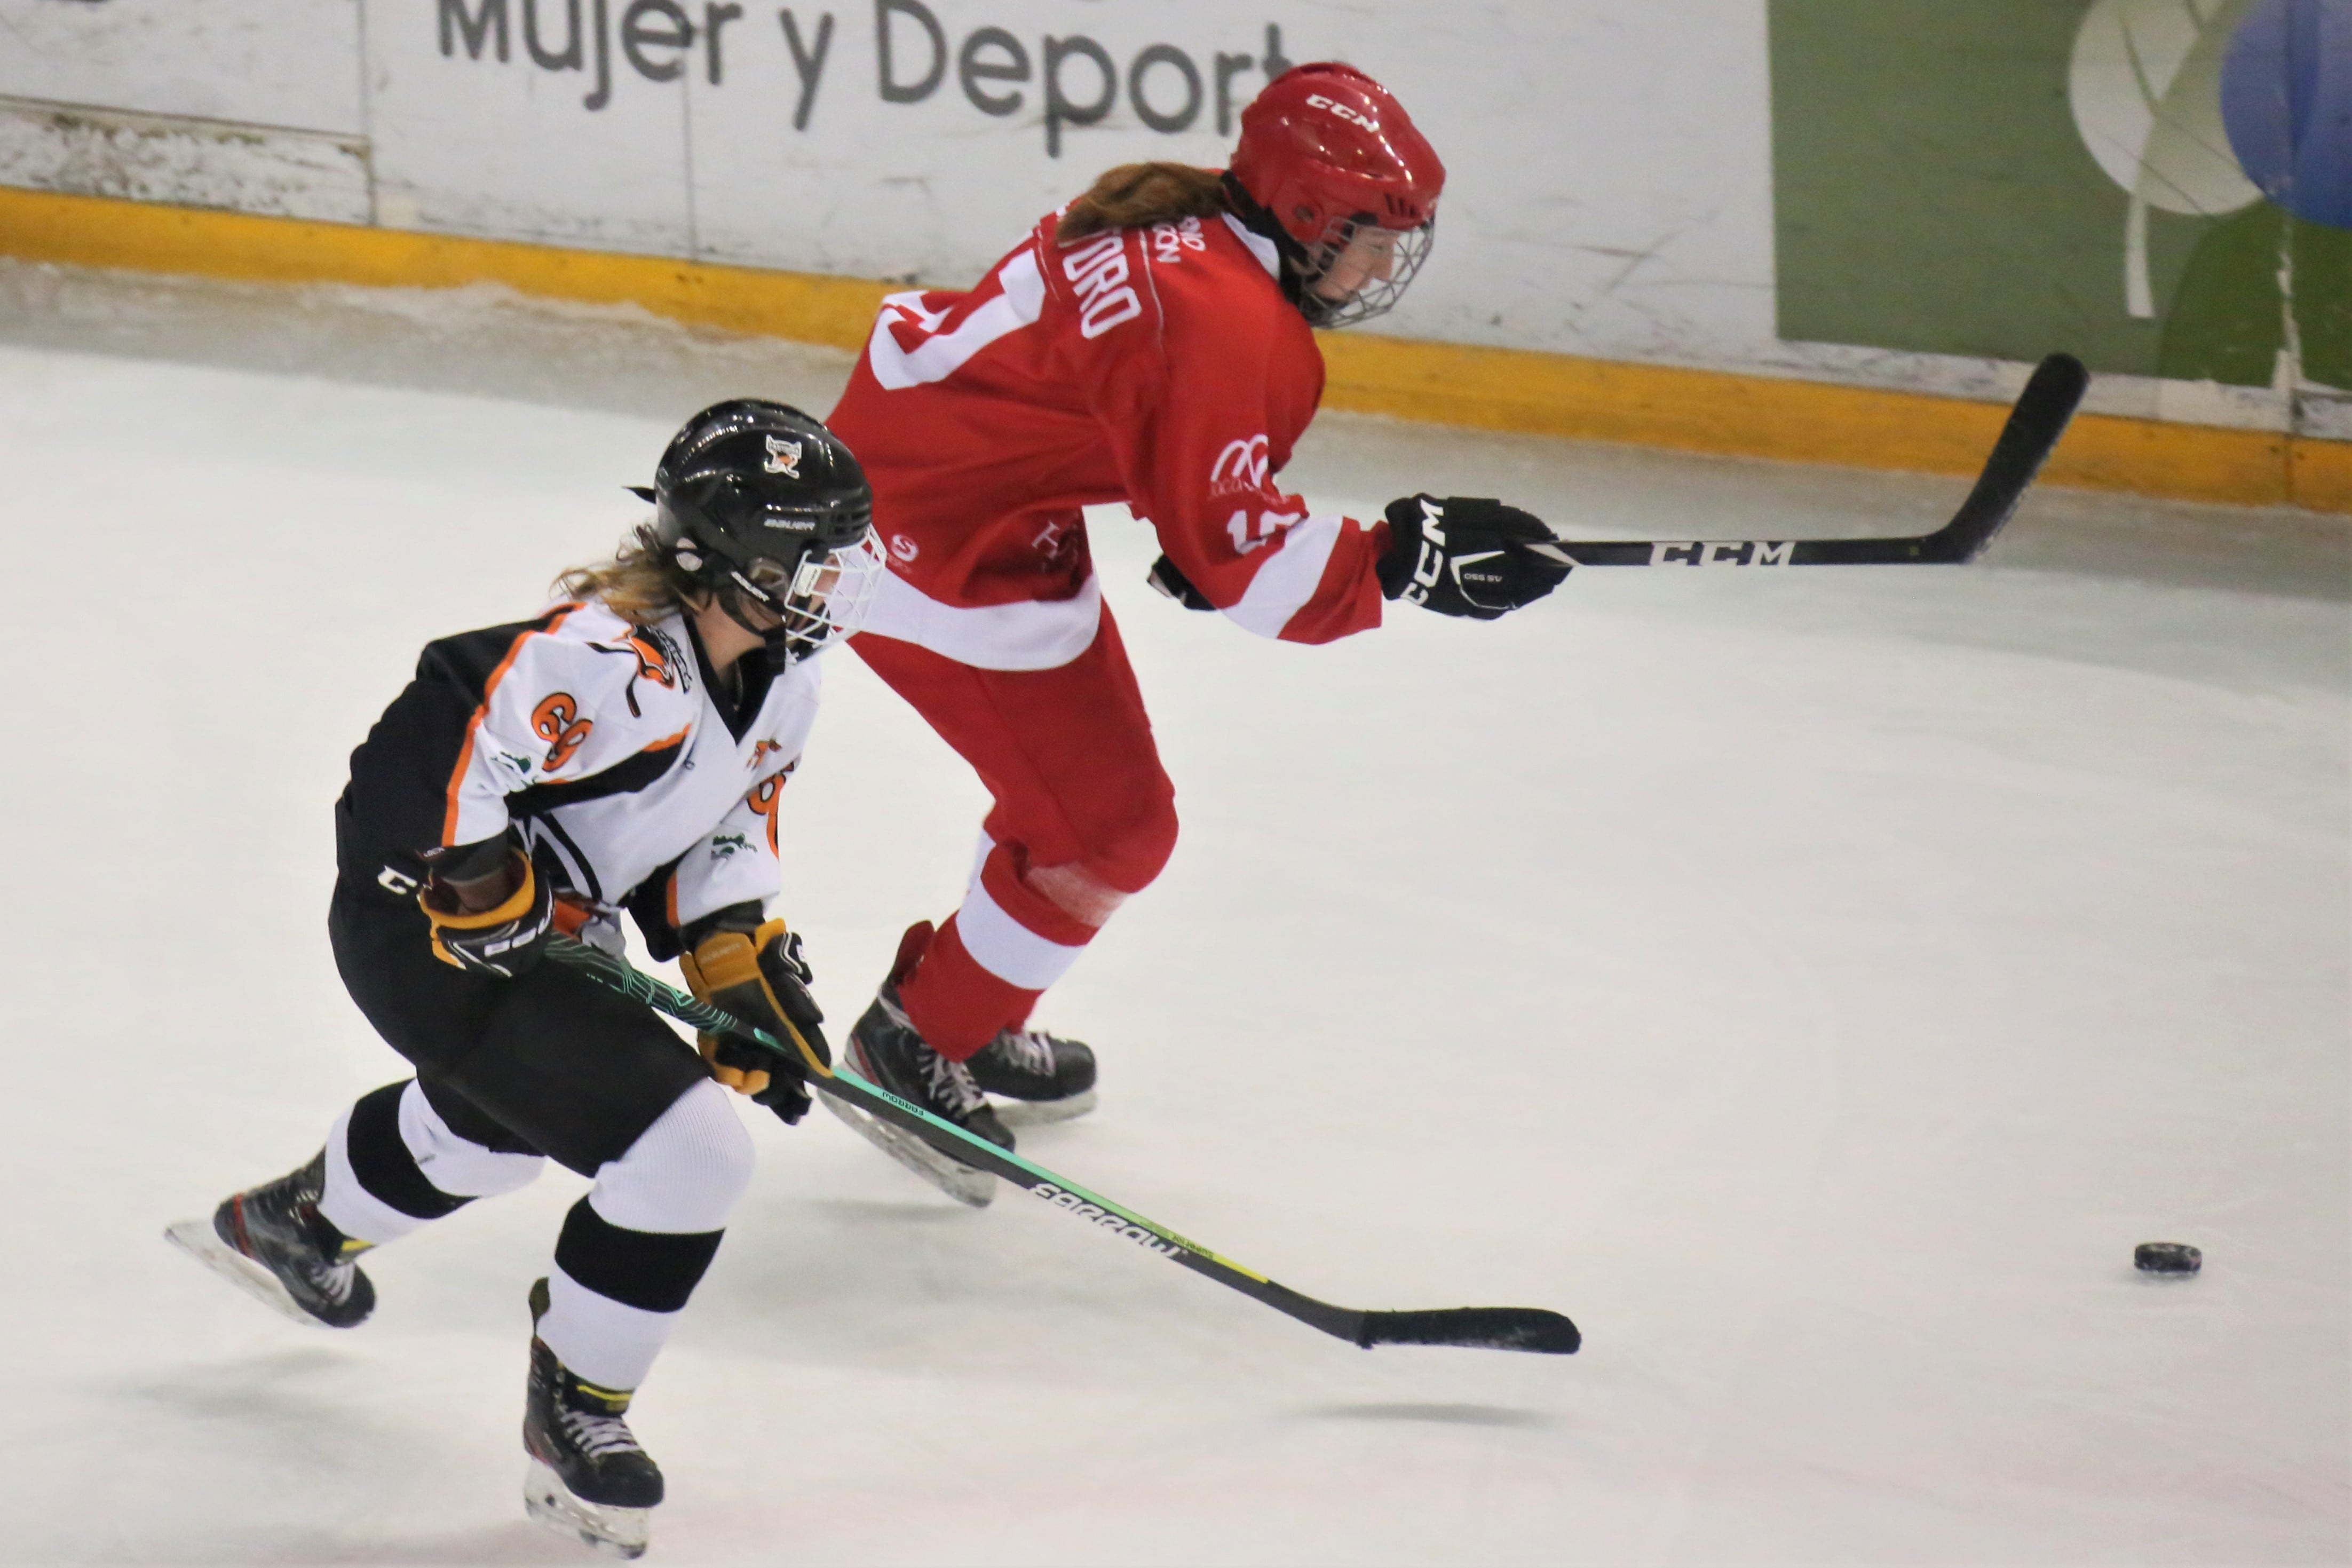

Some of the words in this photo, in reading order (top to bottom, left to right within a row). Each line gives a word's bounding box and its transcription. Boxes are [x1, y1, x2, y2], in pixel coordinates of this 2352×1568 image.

[777, 7, 834, 132] y
[1400, 498, 1446, 607] CCM
[1649, 542, 1796, 566] CCM
